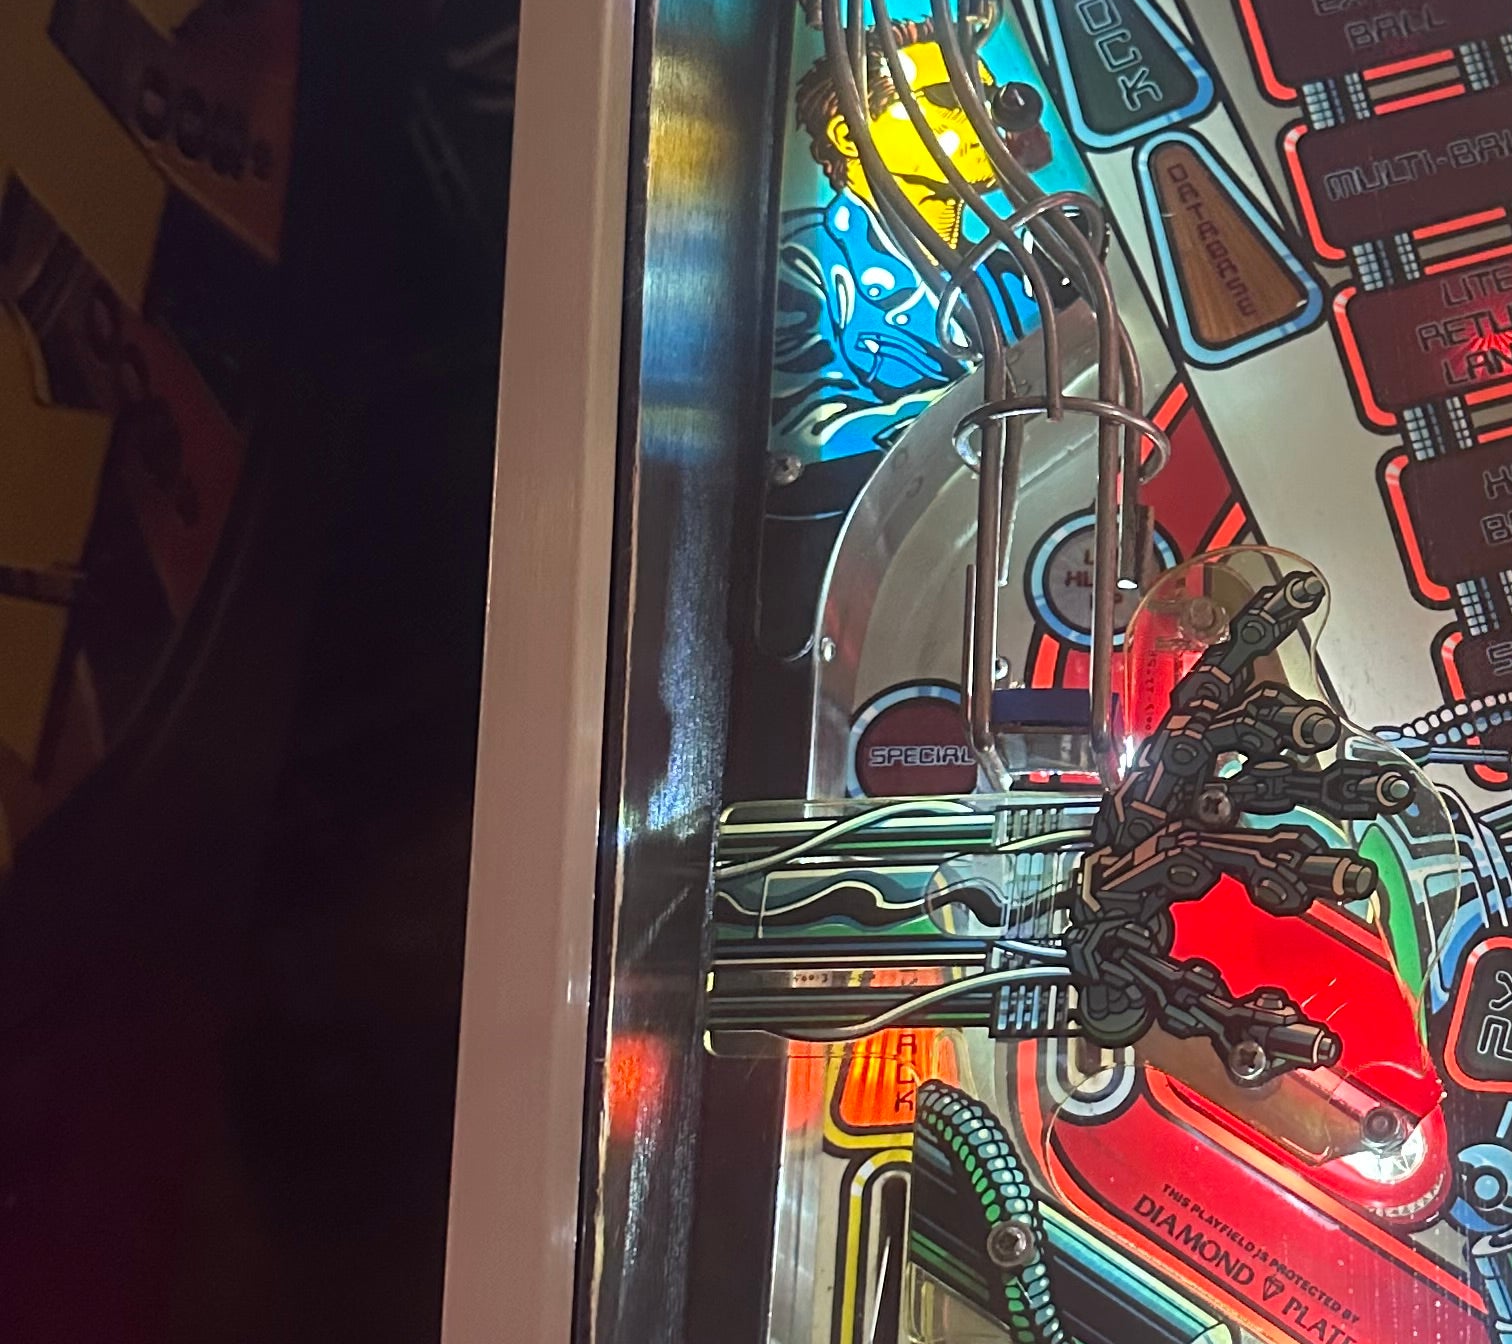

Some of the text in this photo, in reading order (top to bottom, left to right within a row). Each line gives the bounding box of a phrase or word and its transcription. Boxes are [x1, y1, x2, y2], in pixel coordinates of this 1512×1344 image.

[1345, 5, 1447, 51] BALL
[1167, 164, 1258, 317] DATABASE
[868, 745, 976, 768] SPECIAL
[1133, 1193, 1256, 1286] DIAMOND
[1162, 1182, 1361, 1325] THIS PLAYFIELD IS PROTECTED BY
